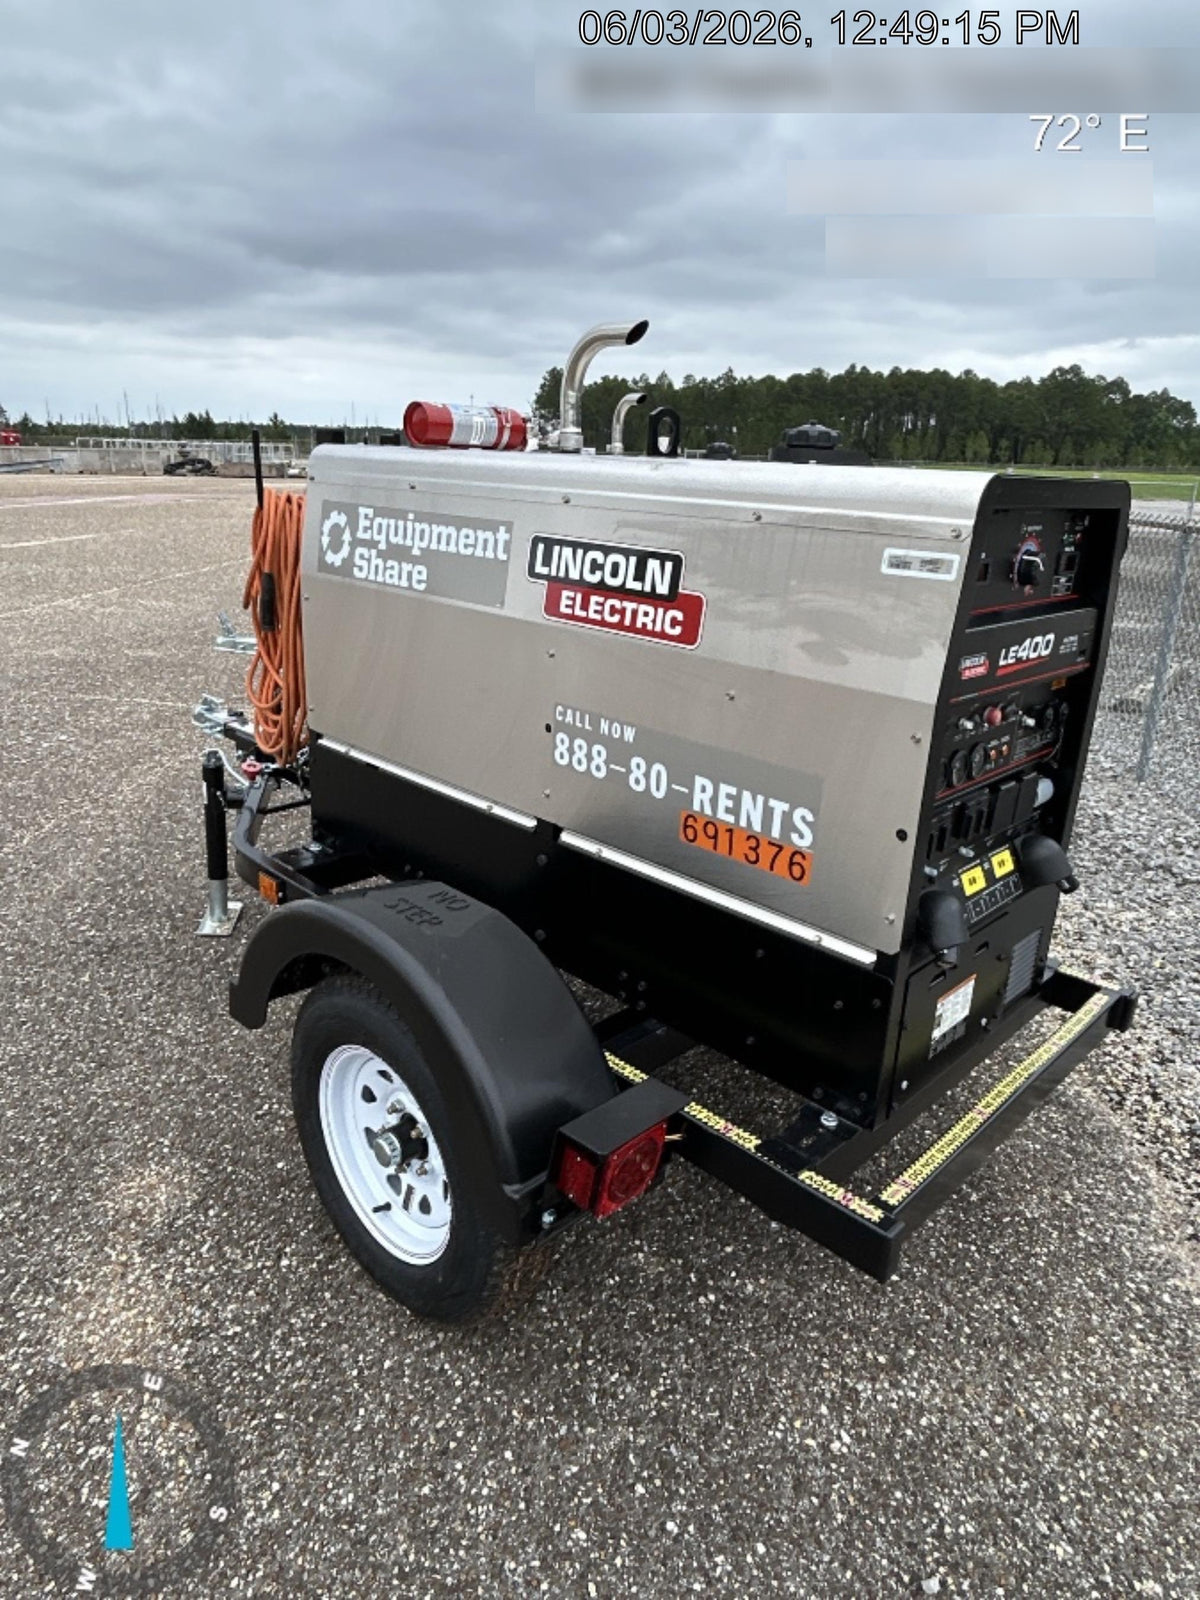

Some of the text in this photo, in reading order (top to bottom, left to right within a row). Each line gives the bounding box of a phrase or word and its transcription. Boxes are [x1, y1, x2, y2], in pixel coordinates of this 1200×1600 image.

[356, 506, 511, 561] Equipment
[353, 546, 428, 591] Share
[534, 543, 674, 596] LINCOLN
[559, 590, 684, 636] ELECTRIC
[998, 633, 1056, 667] LE400
[555, 704, 636, 744] CALL NOW
[554, 732, 815, 848] 888-80-RENTS
[682, 814, 806, 882] 691376
[383, 897, 444, 926] STEP
[427, 890, 471, 911] NO
